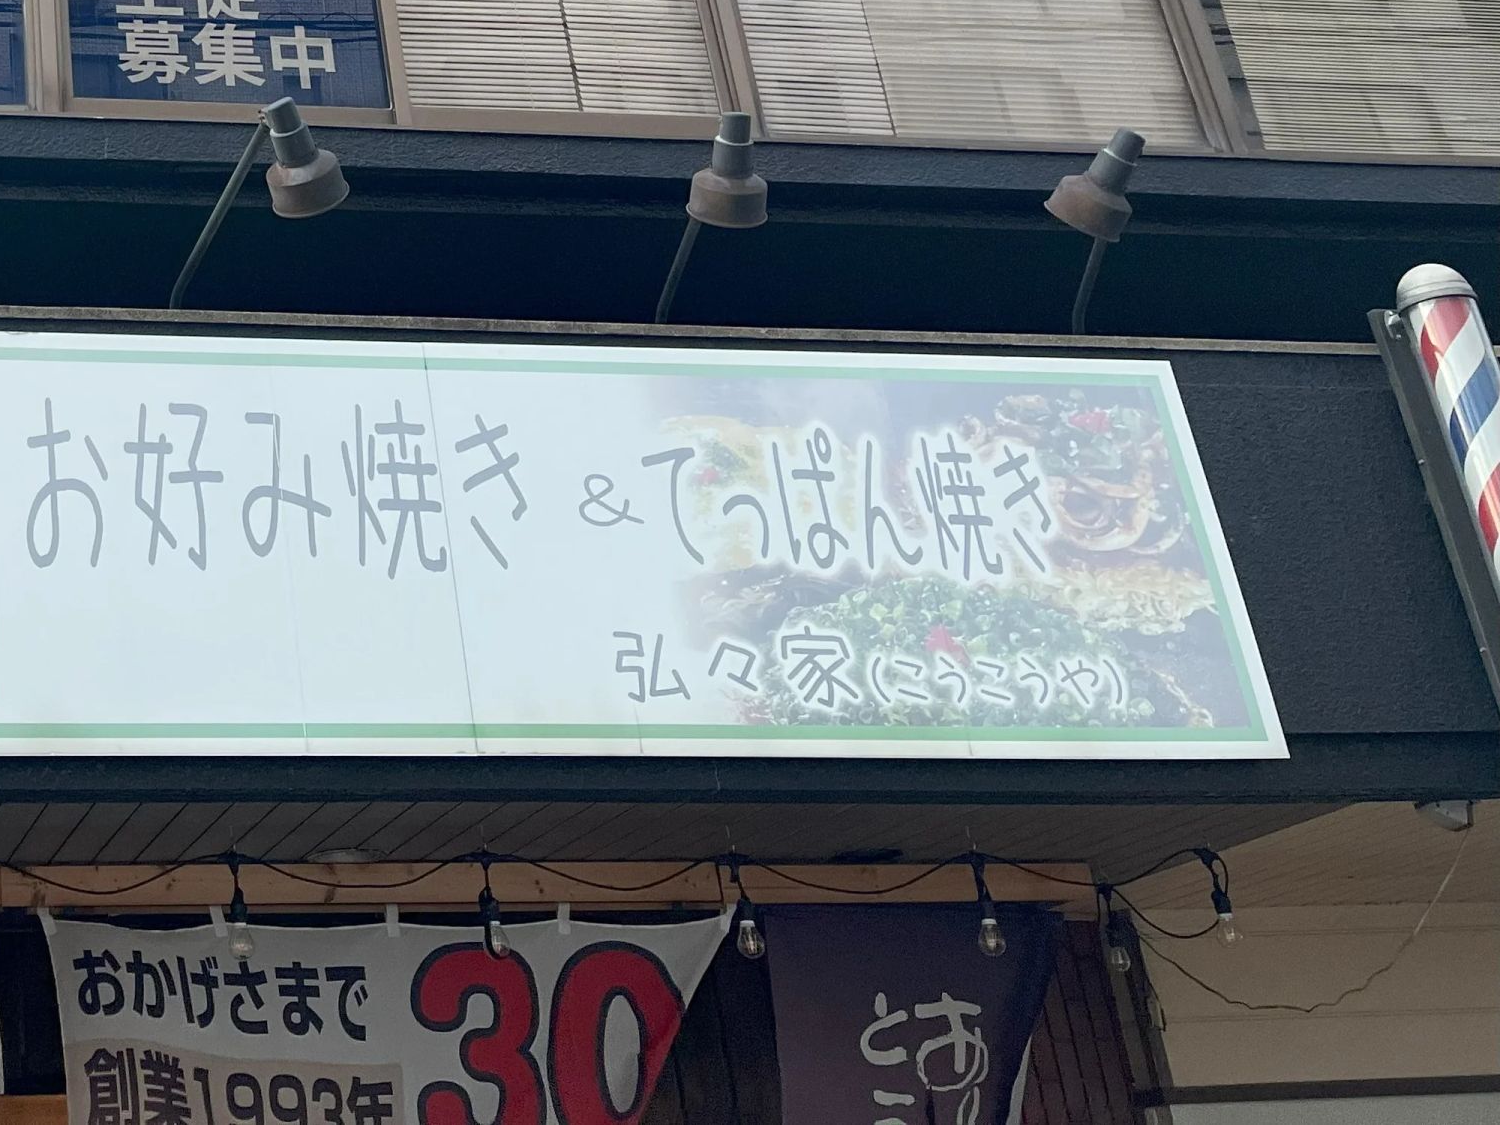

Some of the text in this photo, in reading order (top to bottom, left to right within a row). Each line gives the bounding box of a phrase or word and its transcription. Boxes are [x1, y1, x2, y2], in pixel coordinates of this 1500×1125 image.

[118, 19, 336, 90] 募集中
[25, 396, 528, 580] お好み焼き
[72, 948, 369, 1042] おかげさまで
[83, 1047, 394, 1125] 創業1993年
